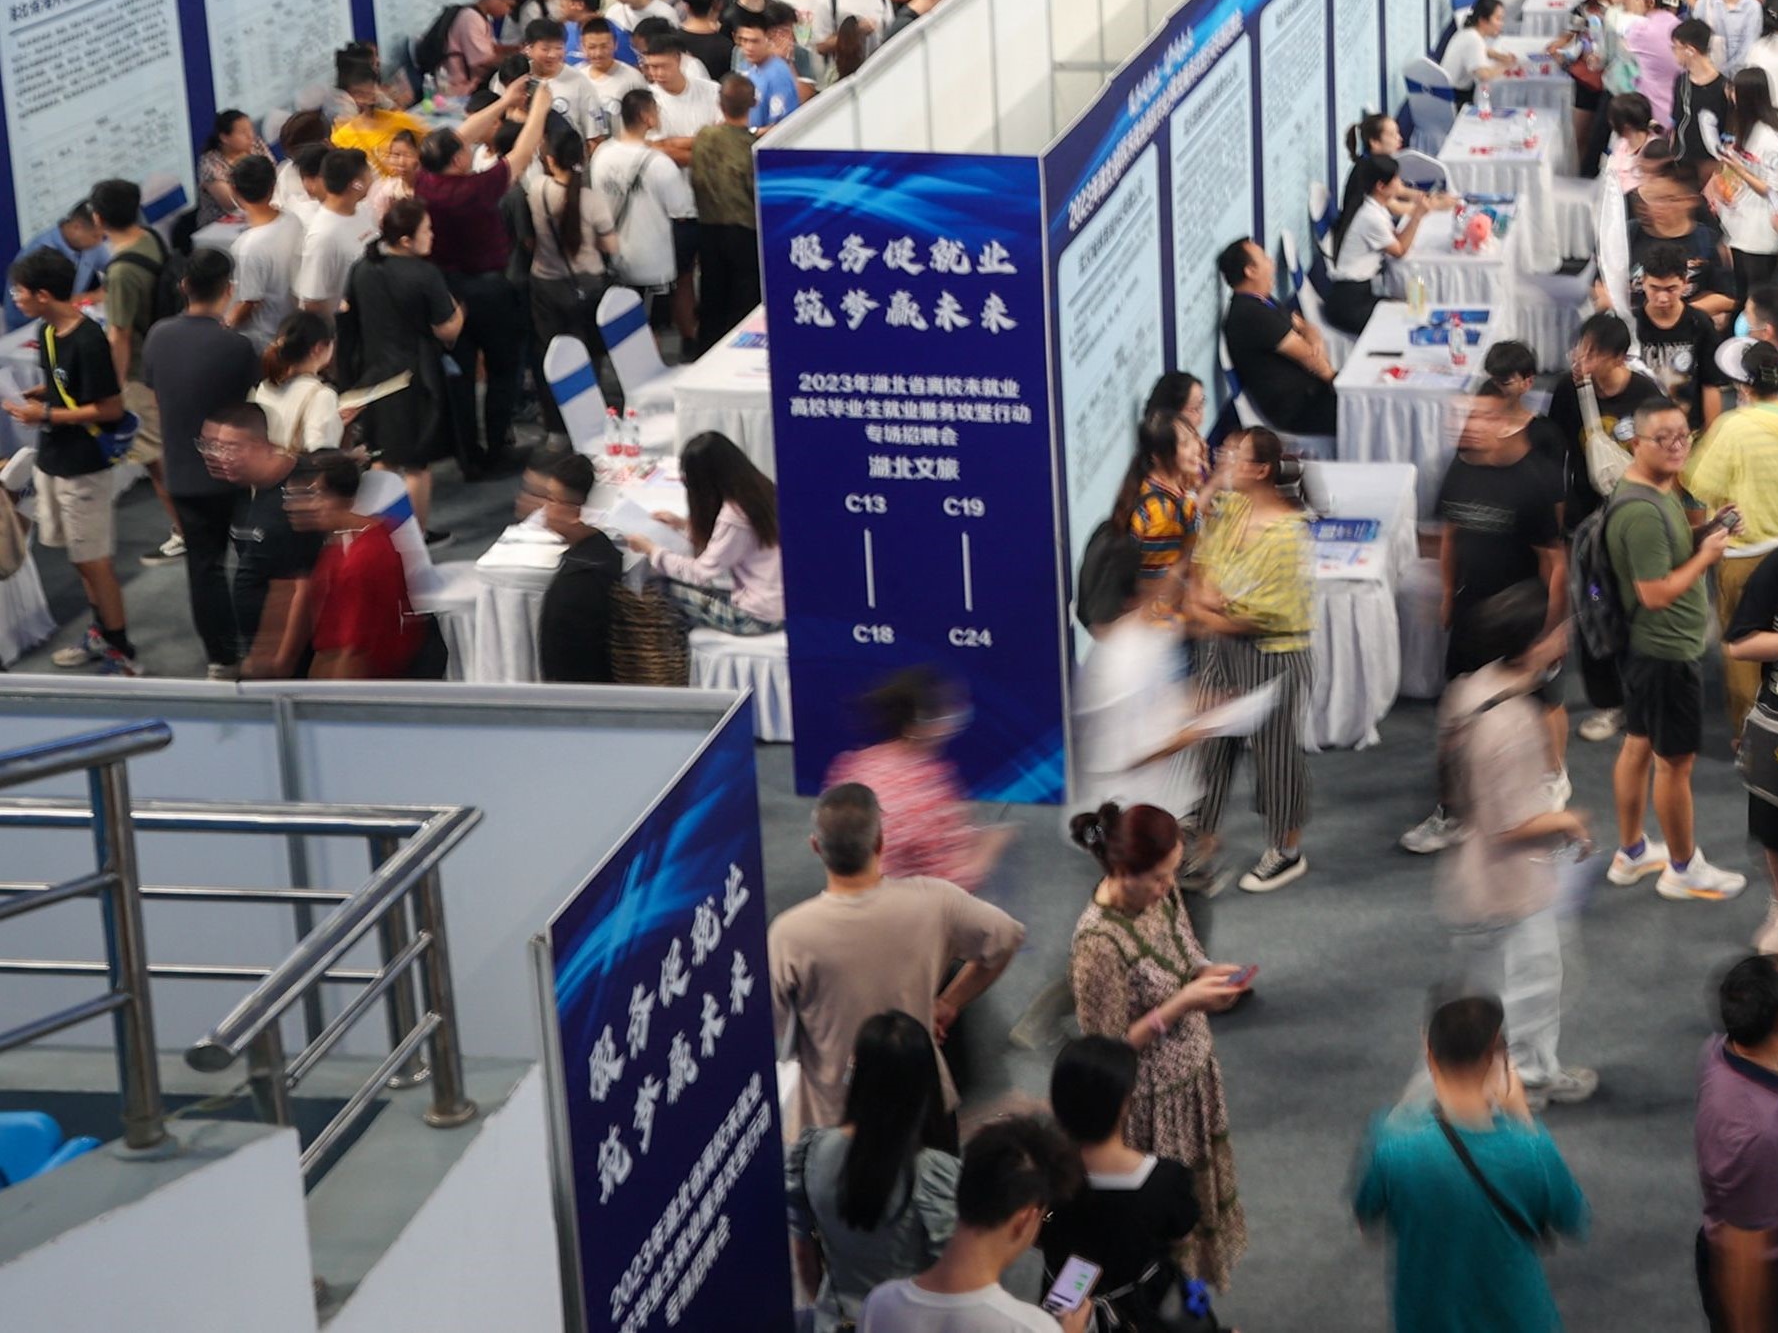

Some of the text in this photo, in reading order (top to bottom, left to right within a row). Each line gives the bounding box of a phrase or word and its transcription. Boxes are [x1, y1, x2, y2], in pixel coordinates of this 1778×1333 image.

[789, 232, 1019, 276] 服务促就业
[792, 287, 1019, 334] 筑梦赢未来
[798, 372, 1021, 399] 2023年湖北省高校未就业
[789, 397, 1032, 424] 高校毕业生就业服务攻坚行动
[864, 423, 959, 447] 专场招聘会
[868, 454, 961, 481] 湖北文旅
[844, 492, 888, 514] C13
[942, 496, 986, 517] C19
[852, 623, 895, 644] C18
[948, 626, 993, 648] C24
[589, 862, 749, 1102] 服务促就业
[597, 949, 754, 1205] 筑梦赢未来
